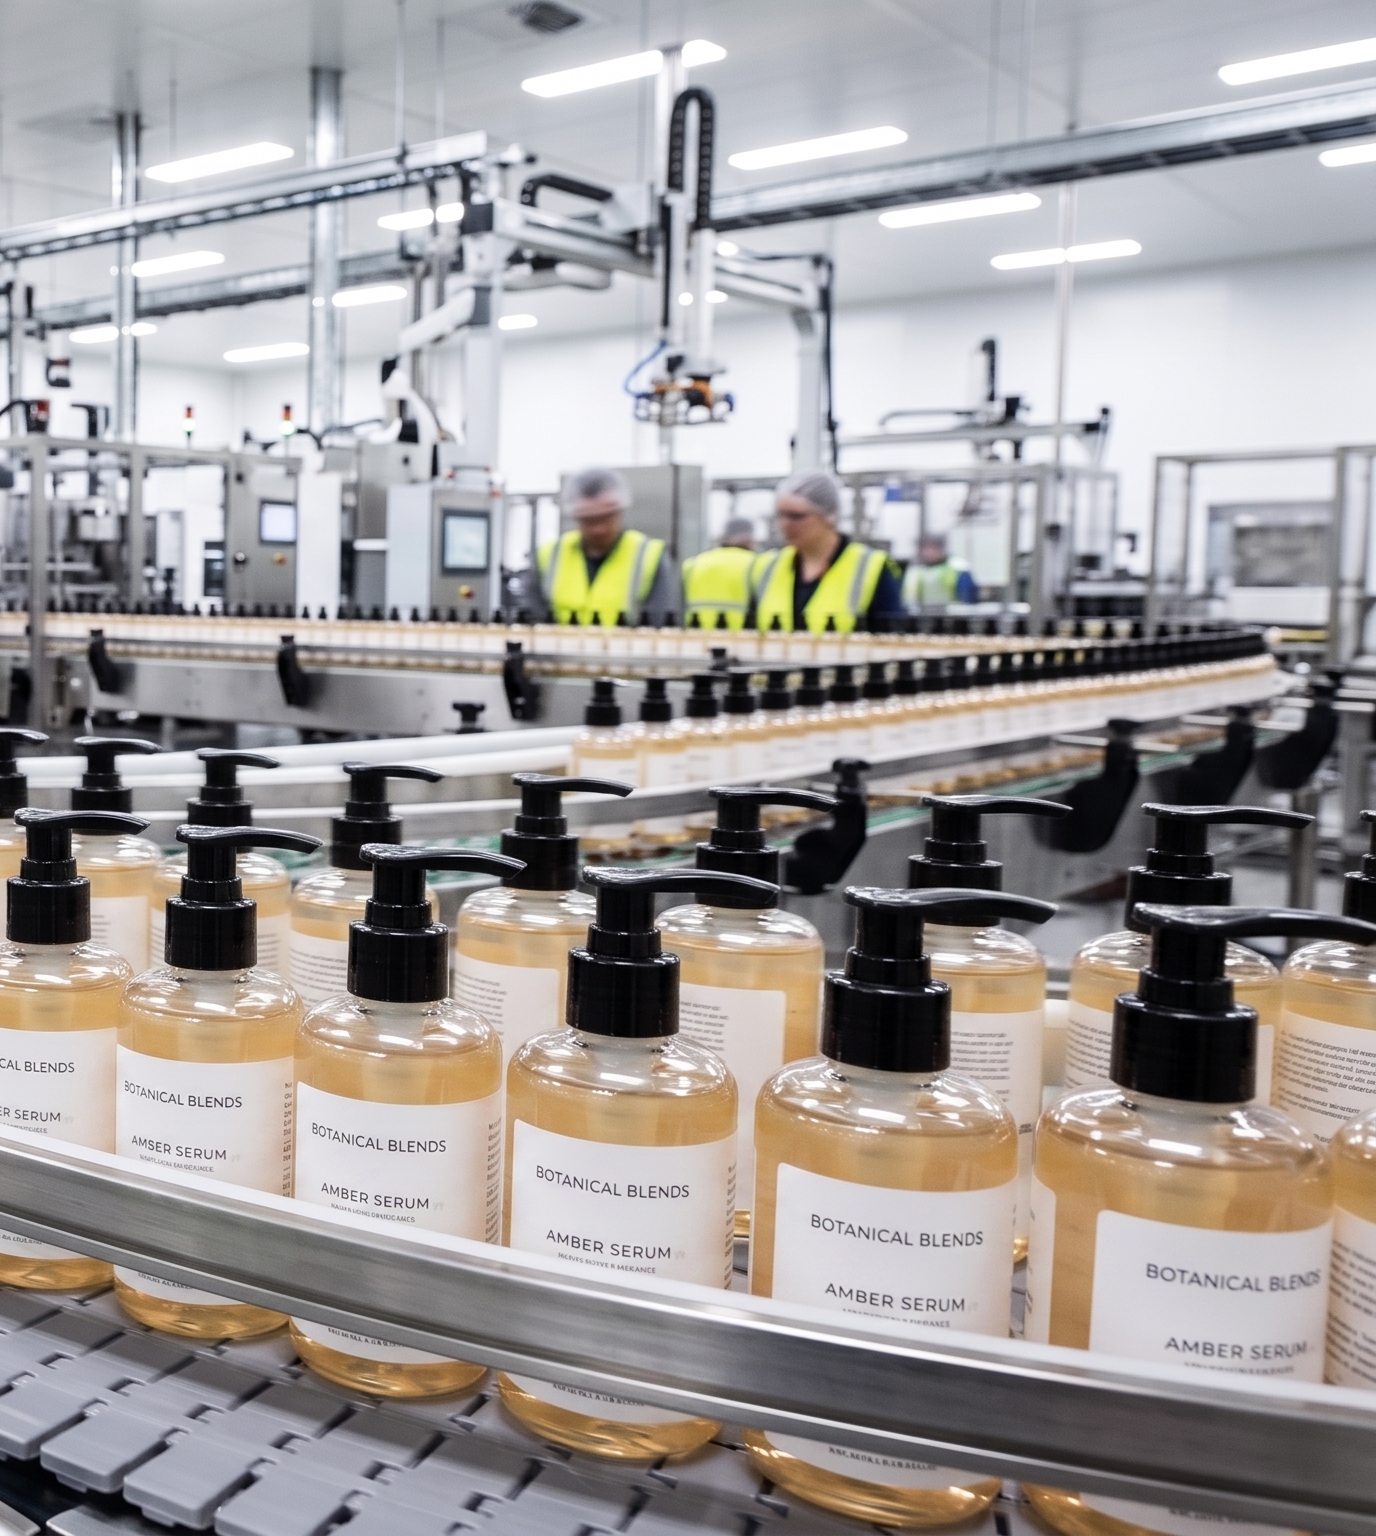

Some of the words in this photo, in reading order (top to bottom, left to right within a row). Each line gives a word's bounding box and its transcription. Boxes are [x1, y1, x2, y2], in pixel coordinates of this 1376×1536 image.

[24, 1060, 76, 1074] BLENDS
[124, 1079, 185, 1106] BOTANICAL
[187, 1094, 243, 1109] BLENDS
[14, 1108, 61, 1123] SERUM
[311, 1122, 384, 1151] BOTANICAL
[387, 1139, 447, 1153] BLENDS
[175, 1145, 227, 1161] SERUM
[320, 1182, 369, 1205] AMBER
[373, 1194, 429, 1210] SERUM
[536, 1164, 623, 1197] BOTANICAL
[627, 1184, 690, 1199] BLENDS
[546, 1229, 604, 1254] AMBER
[610, 1243, 671, 1260] SERUM
[810, 1213, 914, 1247] BOTANICAL
[919, 1230, 984, 1248] BLENDS
[1145, 1262, 1264, 1293] BOTANICAL
[1269, 1269, 1321, 1292] BLENDS
[824, 1282, 894, 1309] AMBER
[901, 1296, 965, 1313] SERUM
[1164, 1337, 1244, 1360] AMBER
[1250, 1341, 1308, 1361] SERUM
